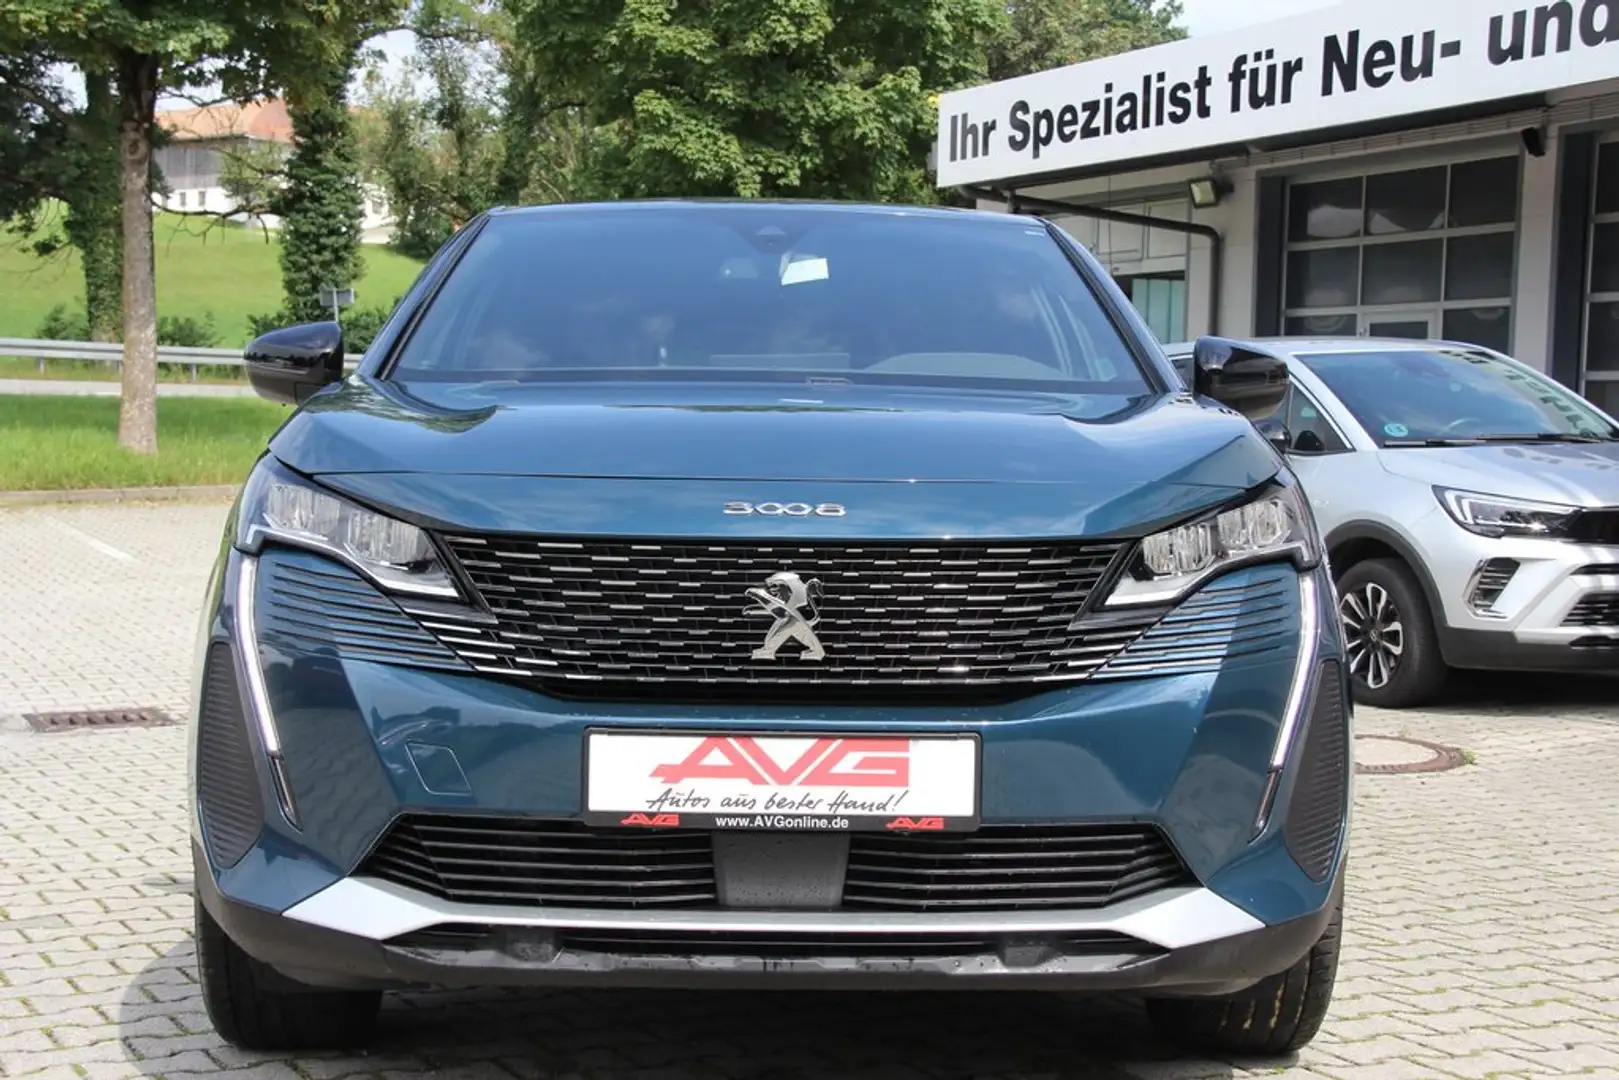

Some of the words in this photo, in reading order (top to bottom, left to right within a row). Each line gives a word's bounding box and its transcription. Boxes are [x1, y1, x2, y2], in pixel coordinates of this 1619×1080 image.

[948, 112, 996, 162] Ihr
[1007, 66, 1211, 160] Spezialist
[1228, 48, 1303, 114] für
[1321, 29, 1461, 96] Neu-
[723, 501, 847, 517] 3008
[648, 736, 910, 787] AVG
[763, 791, 823, 812] bester
[827, 789, 909, 813] Hand!
[621, 812, 680, 827] AVG
[715, 814, 849, 829] www.AVGonline.de
[886, 816, 945, 831] AVG
